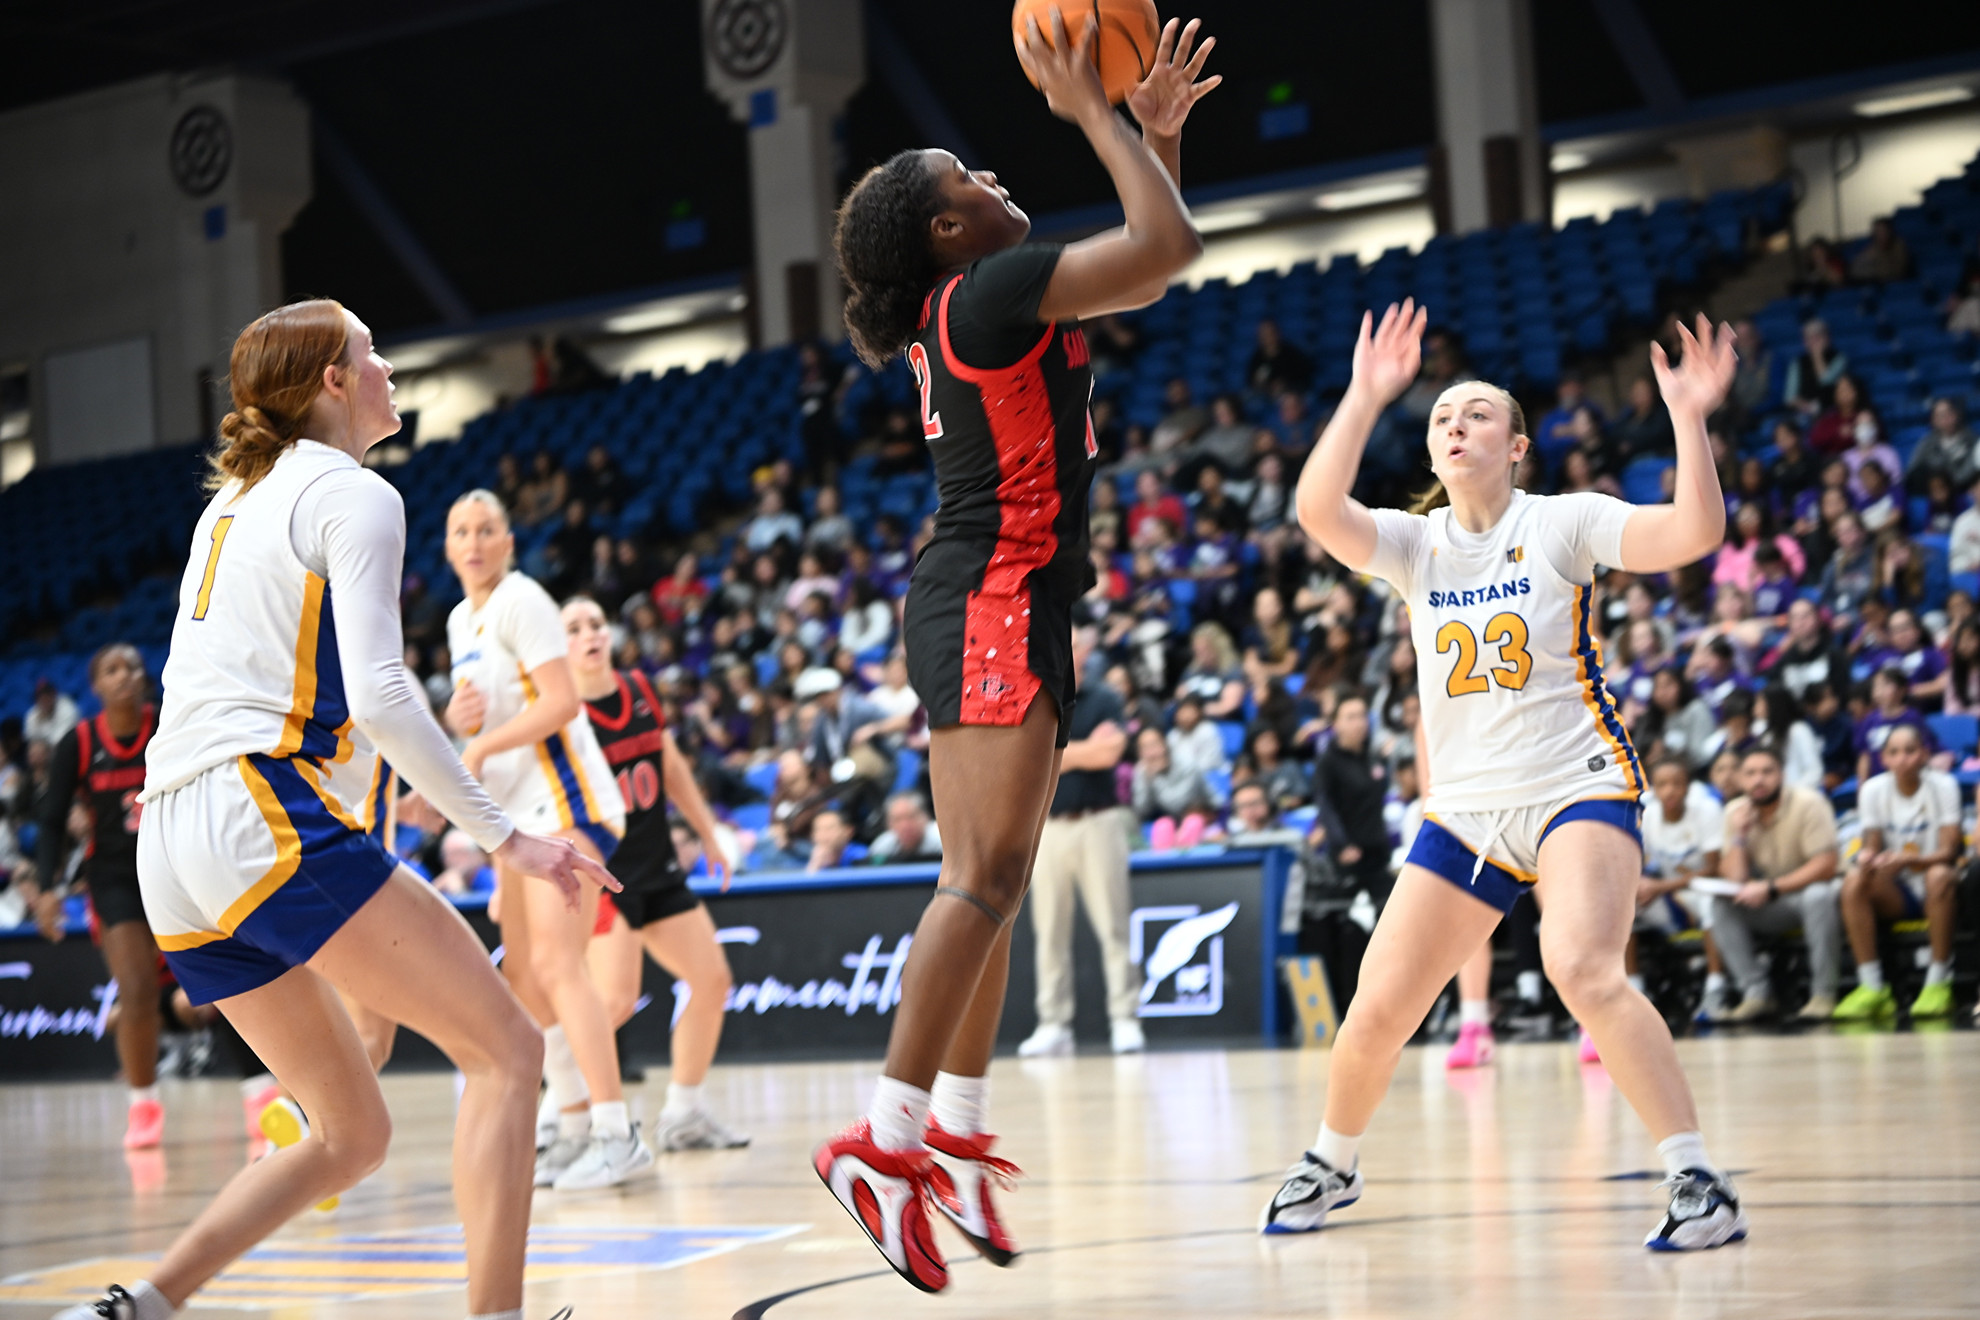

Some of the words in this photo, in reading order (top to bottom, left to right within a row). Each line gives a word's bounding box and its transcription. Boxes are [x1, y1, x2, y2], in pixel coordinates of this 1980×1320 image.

[191, 514, 235, 621] 1
[1436, 611, 1533, 698] 23
[616, 760, 659, 813] 10
